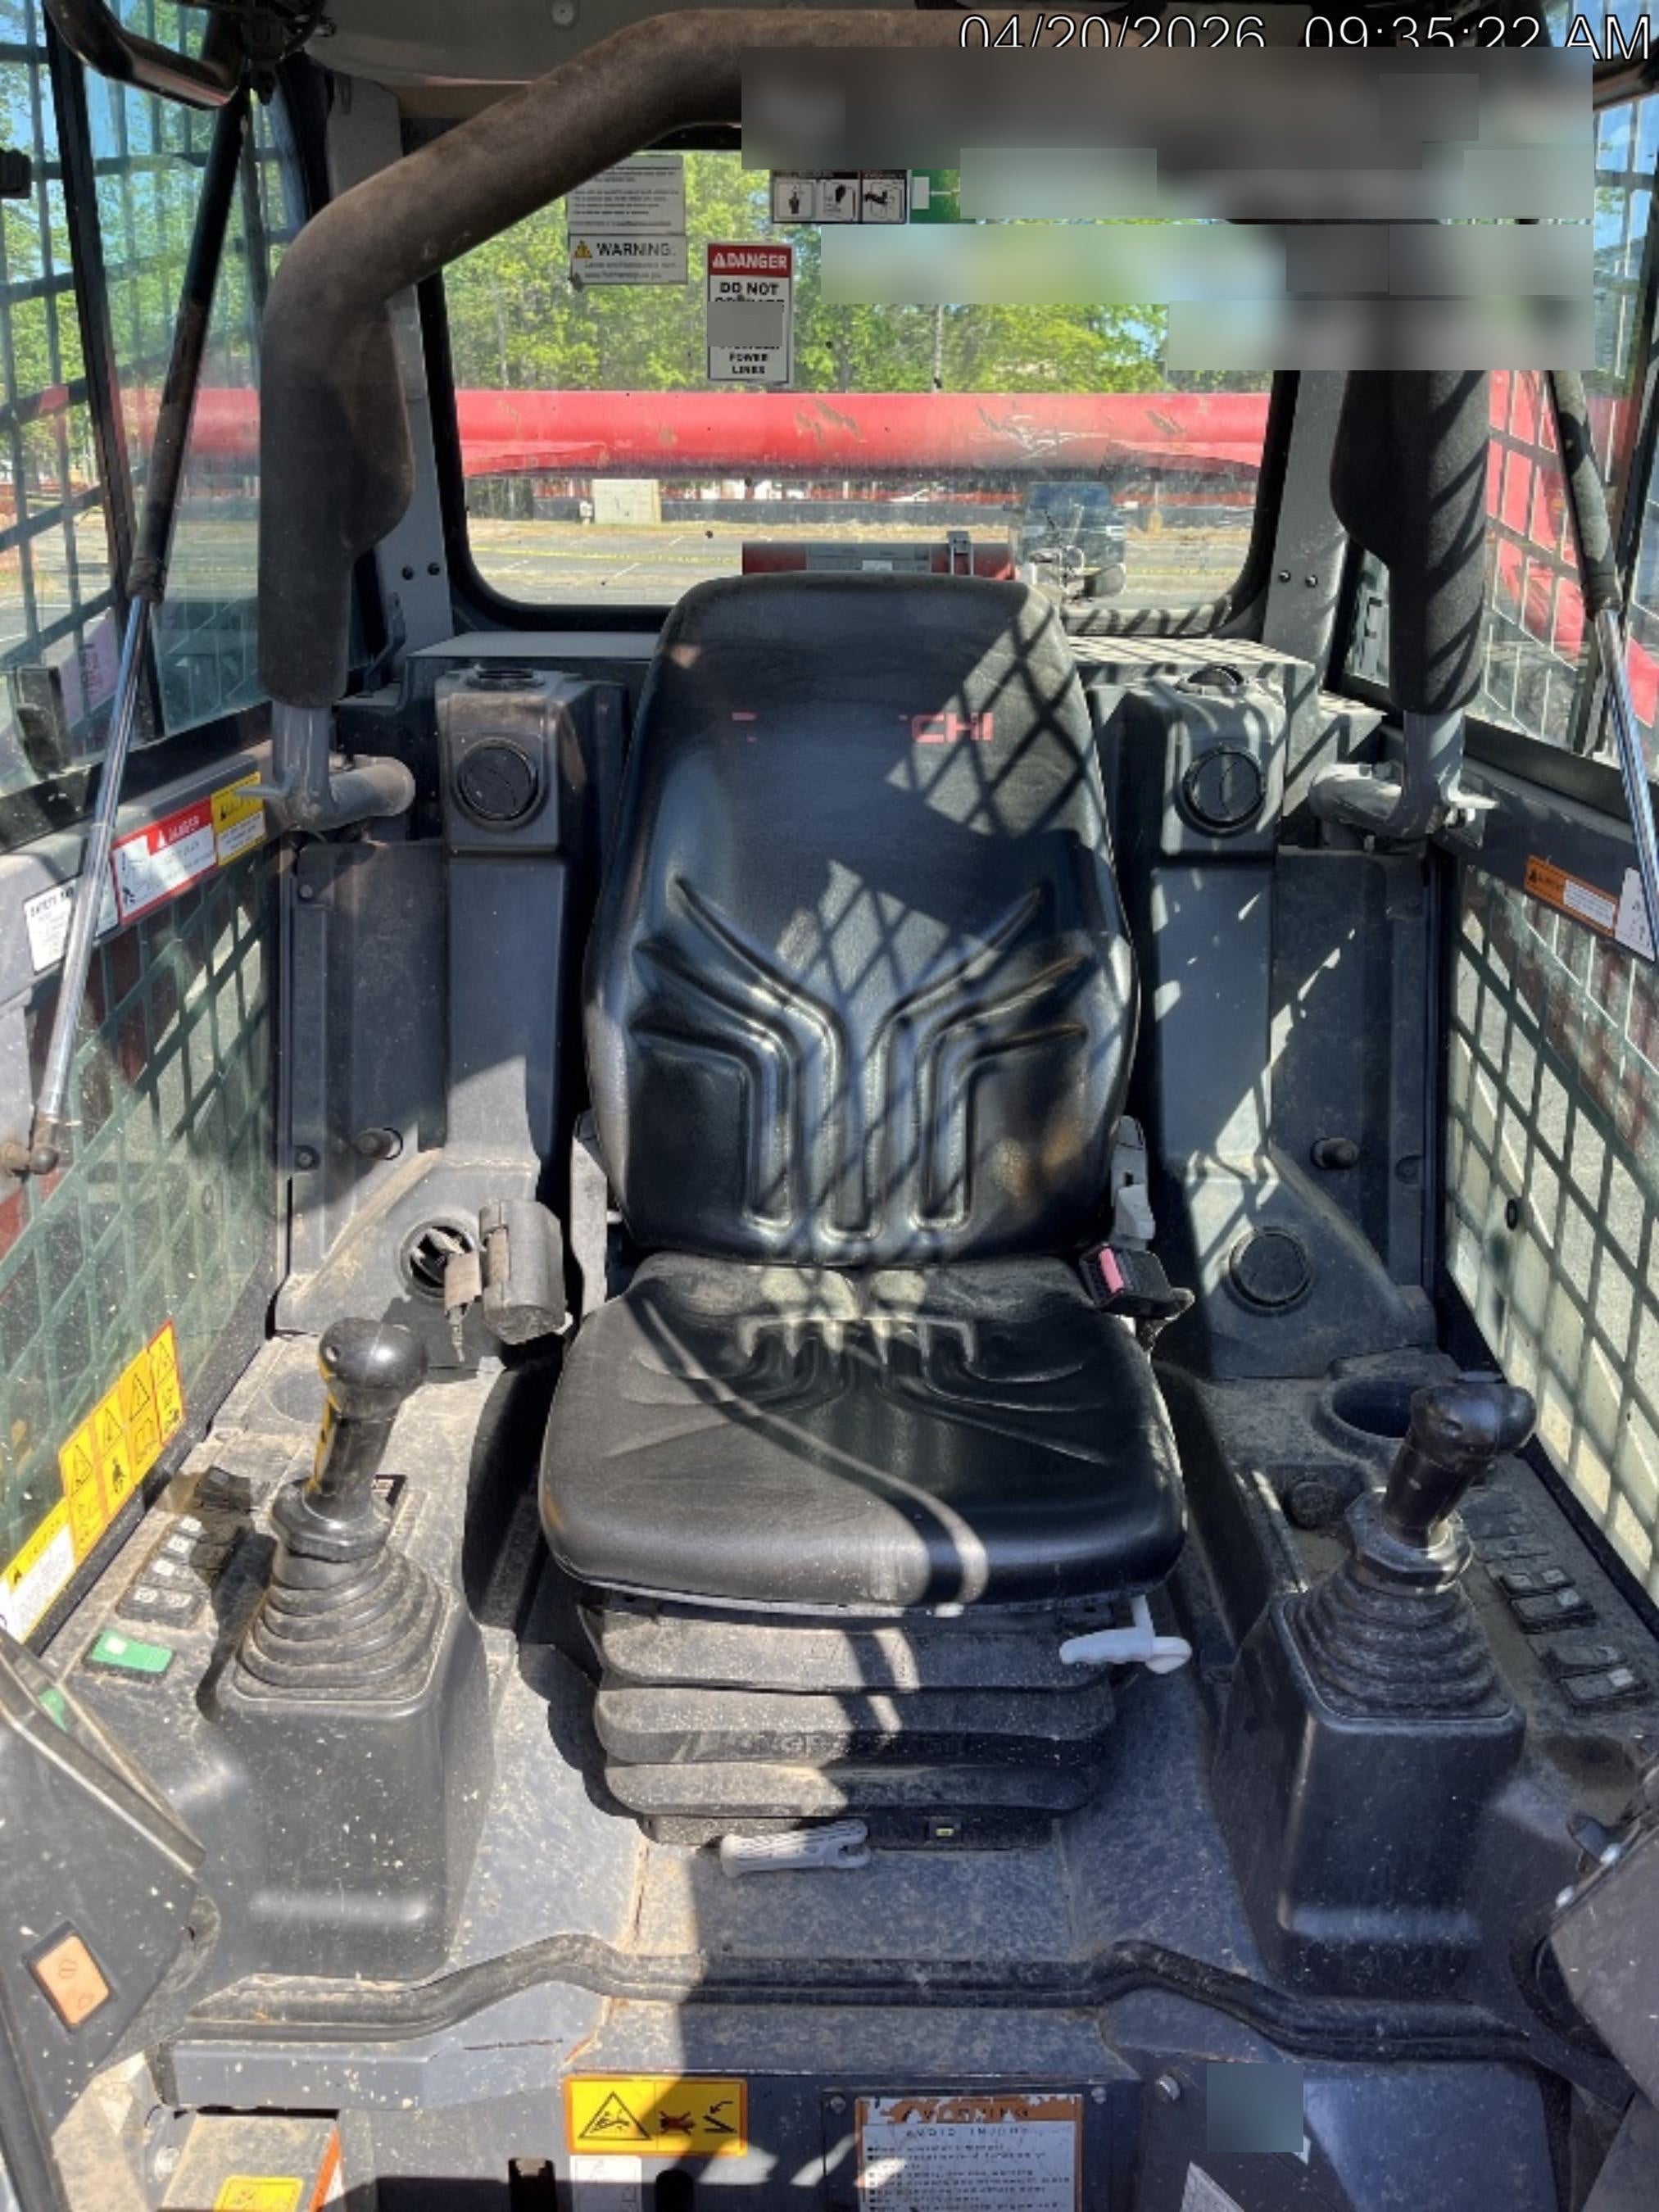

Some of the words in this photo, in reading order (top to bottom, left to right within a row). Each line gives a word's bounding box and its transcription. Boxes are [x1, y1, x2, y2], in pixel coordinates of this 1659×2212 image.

[727, 253, 787, 270] DANGER
[719, 282, 743, 293] DO
[746, 283, 780, 296] NOT
